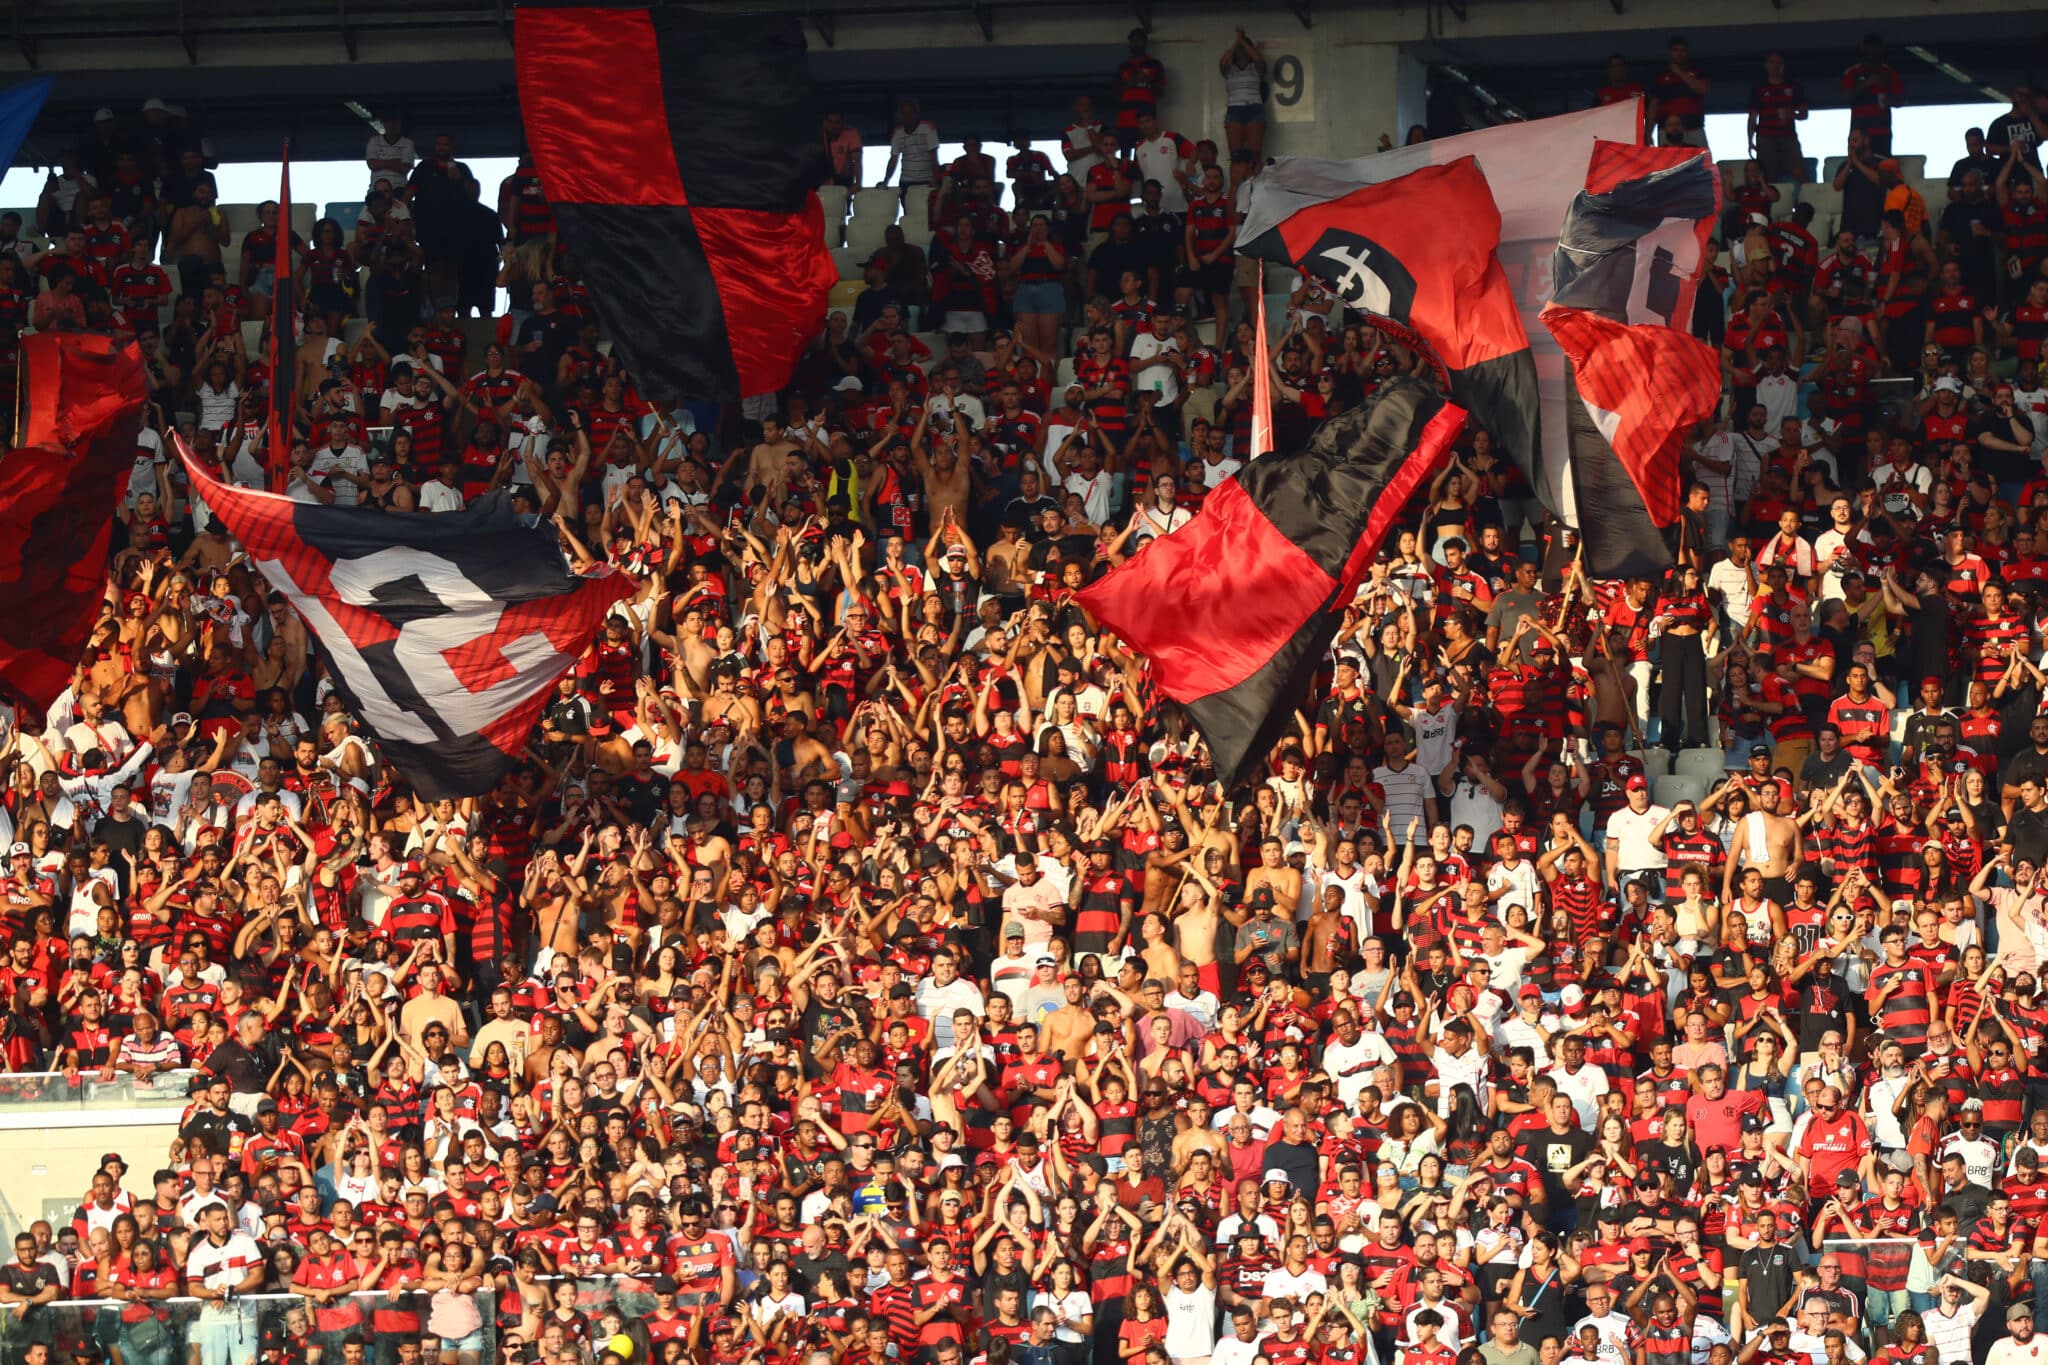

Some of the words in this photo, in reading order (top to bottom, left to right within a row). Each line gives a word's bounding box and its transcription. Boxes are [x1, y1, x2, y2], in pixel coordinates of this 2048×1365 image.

[1273, 54, 1305, 106] 9
[1792, 923, 1820, 956] 87
[1967, 1165, 1988, 1176] BRB
[1596, 1344, 1615, 1354] BRB
